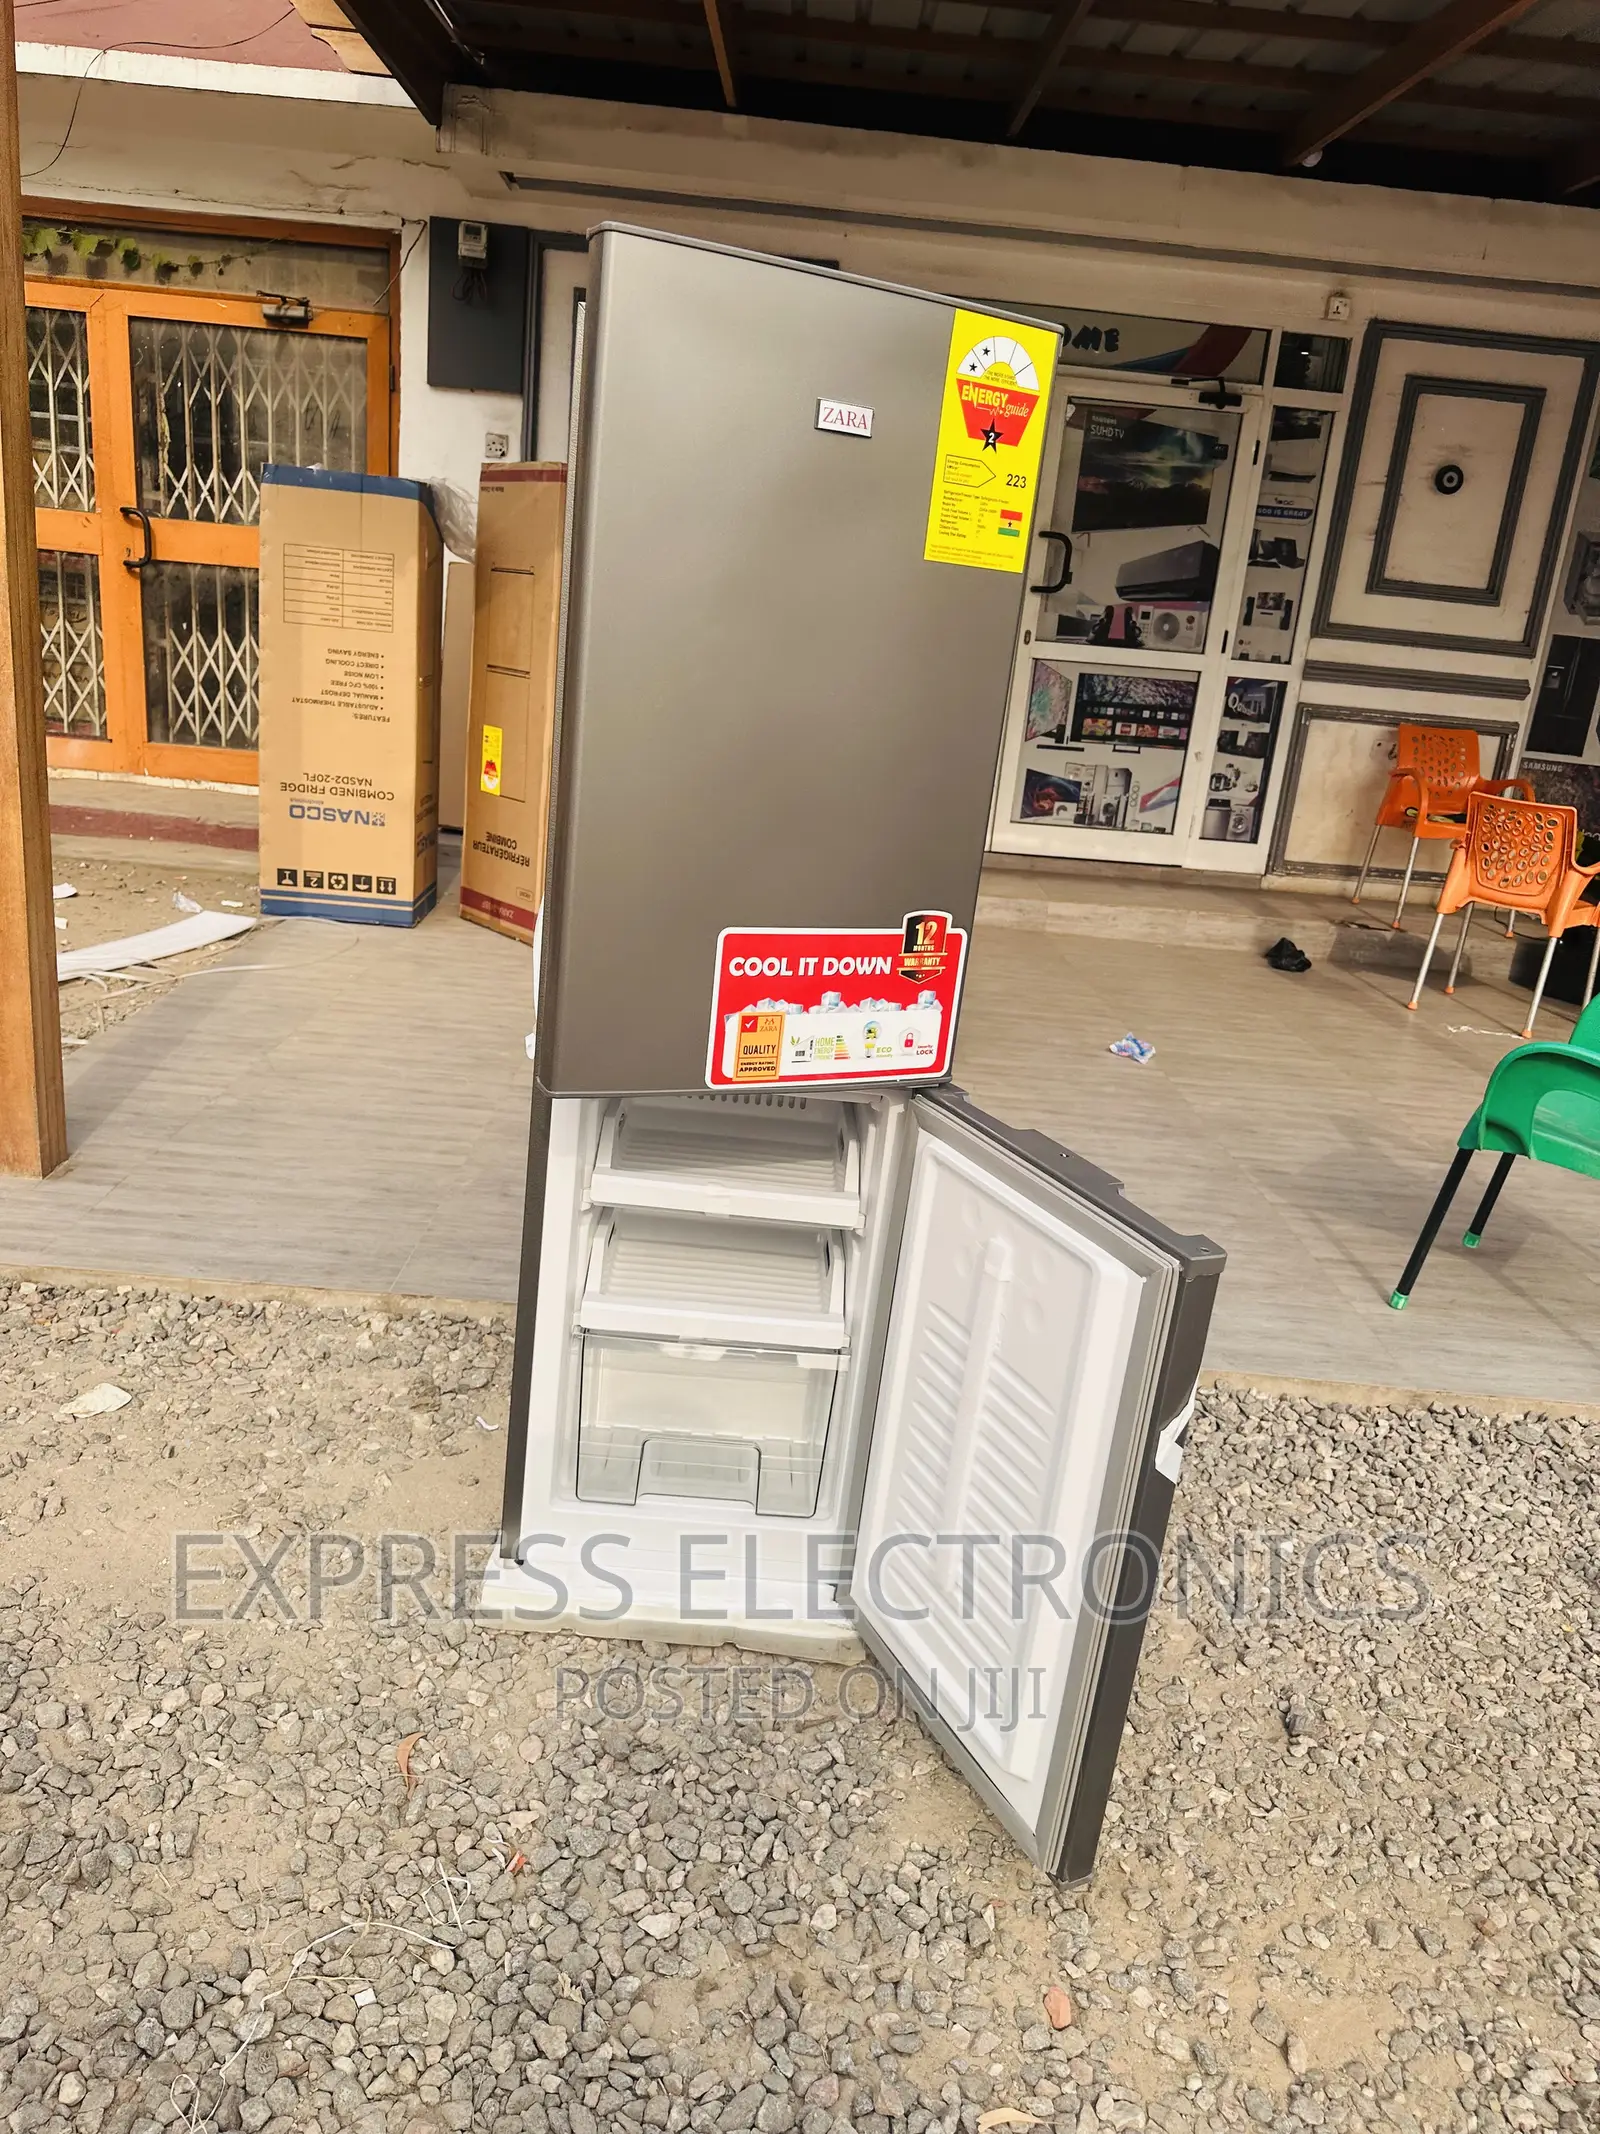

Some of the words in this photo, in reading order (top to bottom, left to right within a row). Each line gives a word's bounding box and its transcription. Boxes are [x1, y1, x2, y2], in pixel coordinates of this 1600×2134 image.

[961, 381, 1009, 408] ENERGY
[1004, 402, 1030, 418] guide
[823, 407, 868, 430] ZARA
[988, 432, 995, 443] 2
[1006, 473, 1027, 489] 223
[327, 648, 352, 656] SAVING
[353, 650, 379, 659] ENERGY
[325, 658, 355, 667] COOLING
[356, 661, 379, 669] DIRECT
[344, 670, 363, 678] NOISE
[320, 689, 351, 698] DEFROST
[352, 692, 379, 700] MANUAL
[291, 696, 336, 707] THERMOSTAT
[337, 701, 379, 710] ADJUSTABLE
[352, 712, 391, 723] FEATURES:
[1522, 761, 1563, 772] SAMSUNG
[303, 772, 373, 787] NASD2-20FL
[280, 782, 326, 795] FRIDGE
[329, 786, 395, 801] COMBINED
[289, 804, 370, 825] NASCO
[916, 921, 937, 945] 12
[729, 956, 793, 977] COOL
[798, 957, 819, 976] IT
[822, 956, 893, 976] DOWN
[904, 957, 940, 966] WARRANTY
[815, 1037, 835, 1046] HOME
[743, 1045, 776, 1055] QUALITY
